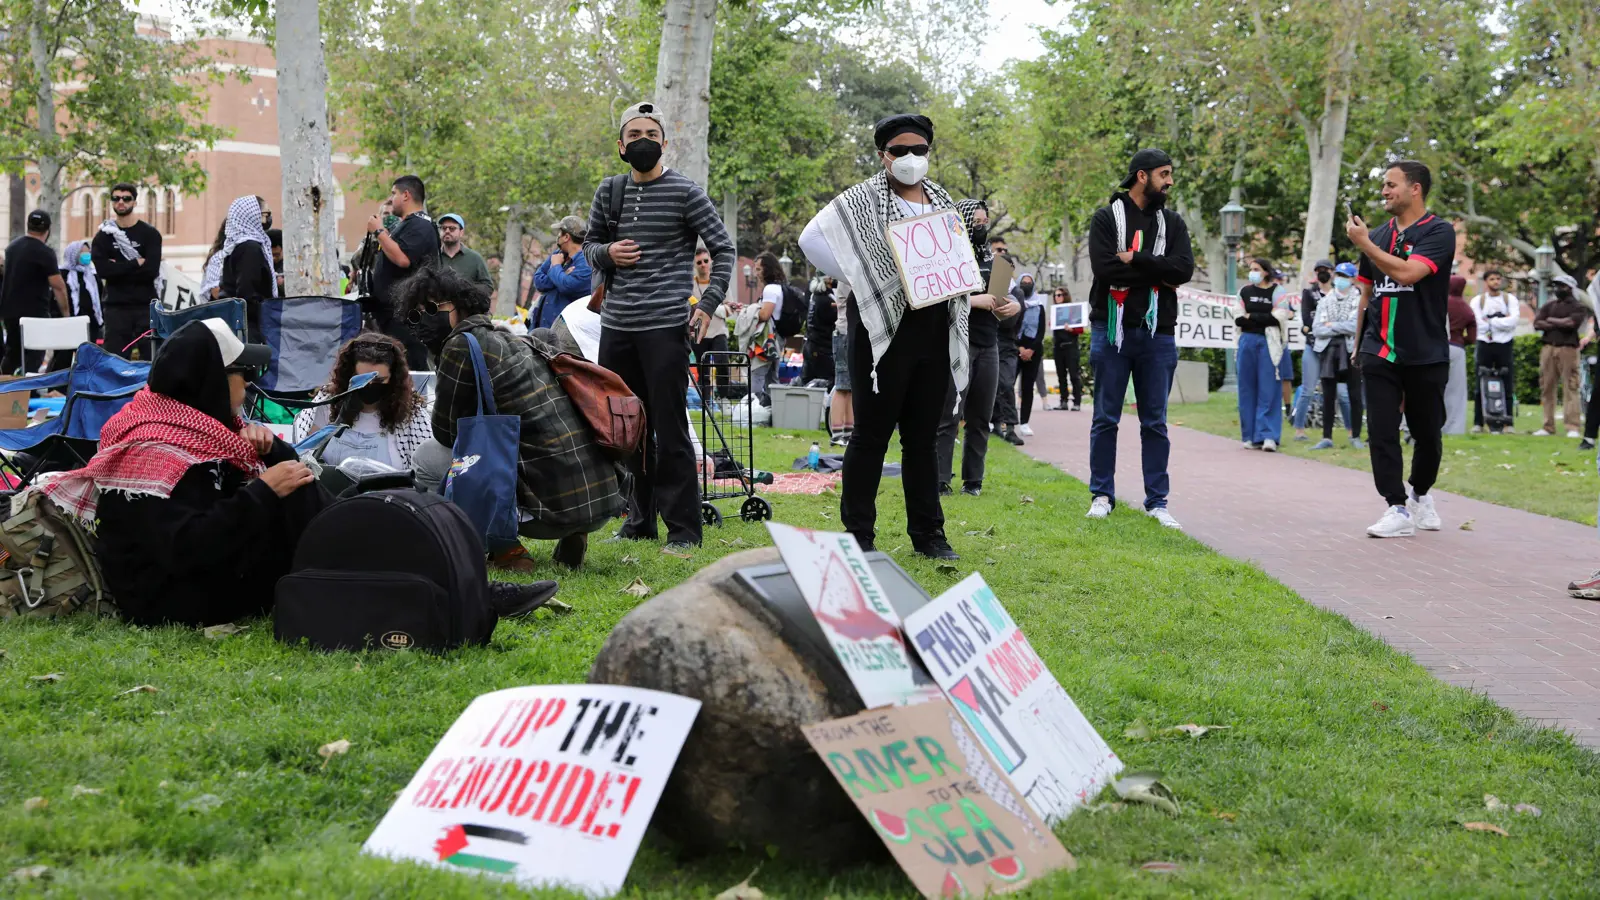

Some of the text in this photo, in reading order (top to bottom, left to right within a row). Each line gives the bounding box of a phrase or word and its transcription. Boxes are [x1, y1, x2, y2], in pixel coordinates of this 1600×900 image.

[893, 217, 952, 263] YOU
[915, 611, 977, 677] THIS
[957, 599, 992, 645] IS
[974, 666, 1012, 716] A
[461, 697, 659, 766] TOP THE
[810, 715, 896, 745] FROM THE
[412, 755, 642, 839] GENOCIDE!
[827, 736, 962, 799] RIVER
[926, 779, 982, 803] TO THE
[906, 797, 1015, 866] SEA
